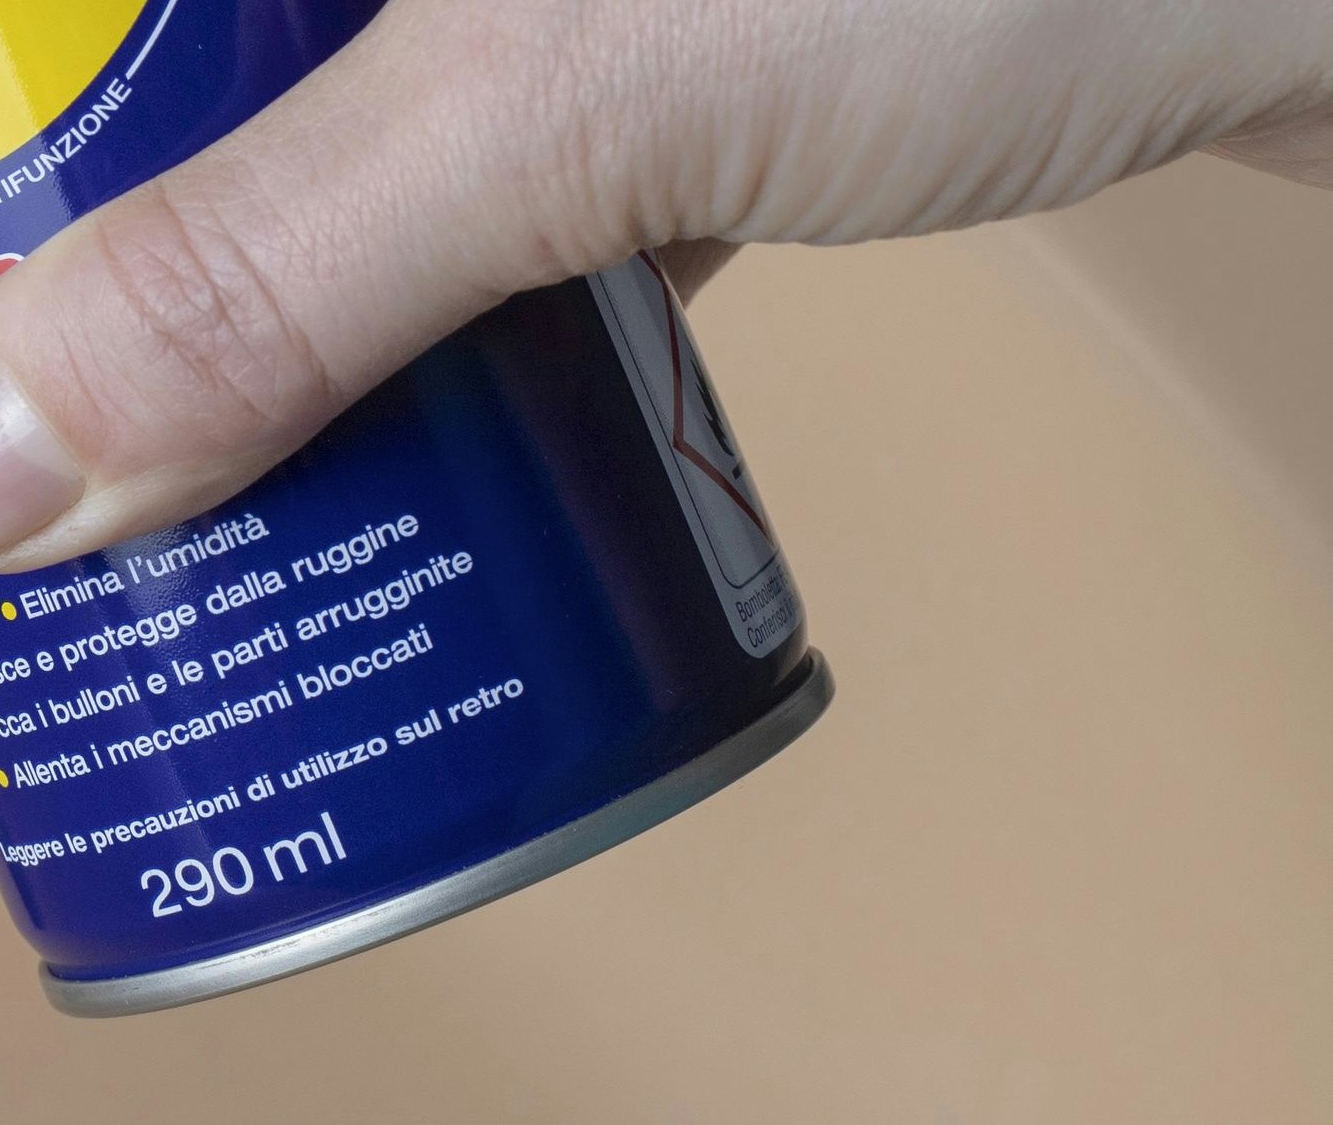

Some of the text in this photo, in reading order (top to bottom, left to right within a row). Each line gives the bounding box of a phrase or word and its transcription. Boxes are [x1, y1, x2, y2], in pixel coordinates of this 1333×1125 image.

[19, 513, 269, 620] Elimina l'umidità
[36, 651, 54, 672] e
[59, 604, 197, 672] protegge
[205, 570, 287, 615] dalla
[291, 514, 419, 582] ruggine
[36, 703, 49, 728] i
[48, 675, 141, 725] bulloni
[147, 673, 167, 695] e
[172, 659, 204, 686] le
[211, 622, 289, 679] parti
[296, 551, 473, 641] arrugginite
[13, 623, 434, 789] Allenta i meccanismi bloccati
[65, 832, 87, 854] le
[90, 786, 241, 854] precauzioni
[247, 774, 276, 802] di
[282, 737, 388, 790] utilizzo
[395, 709, 443, 746] sul
[447, 678, 524, 724] retro
[140, 811, 347, 919] 290 ml
